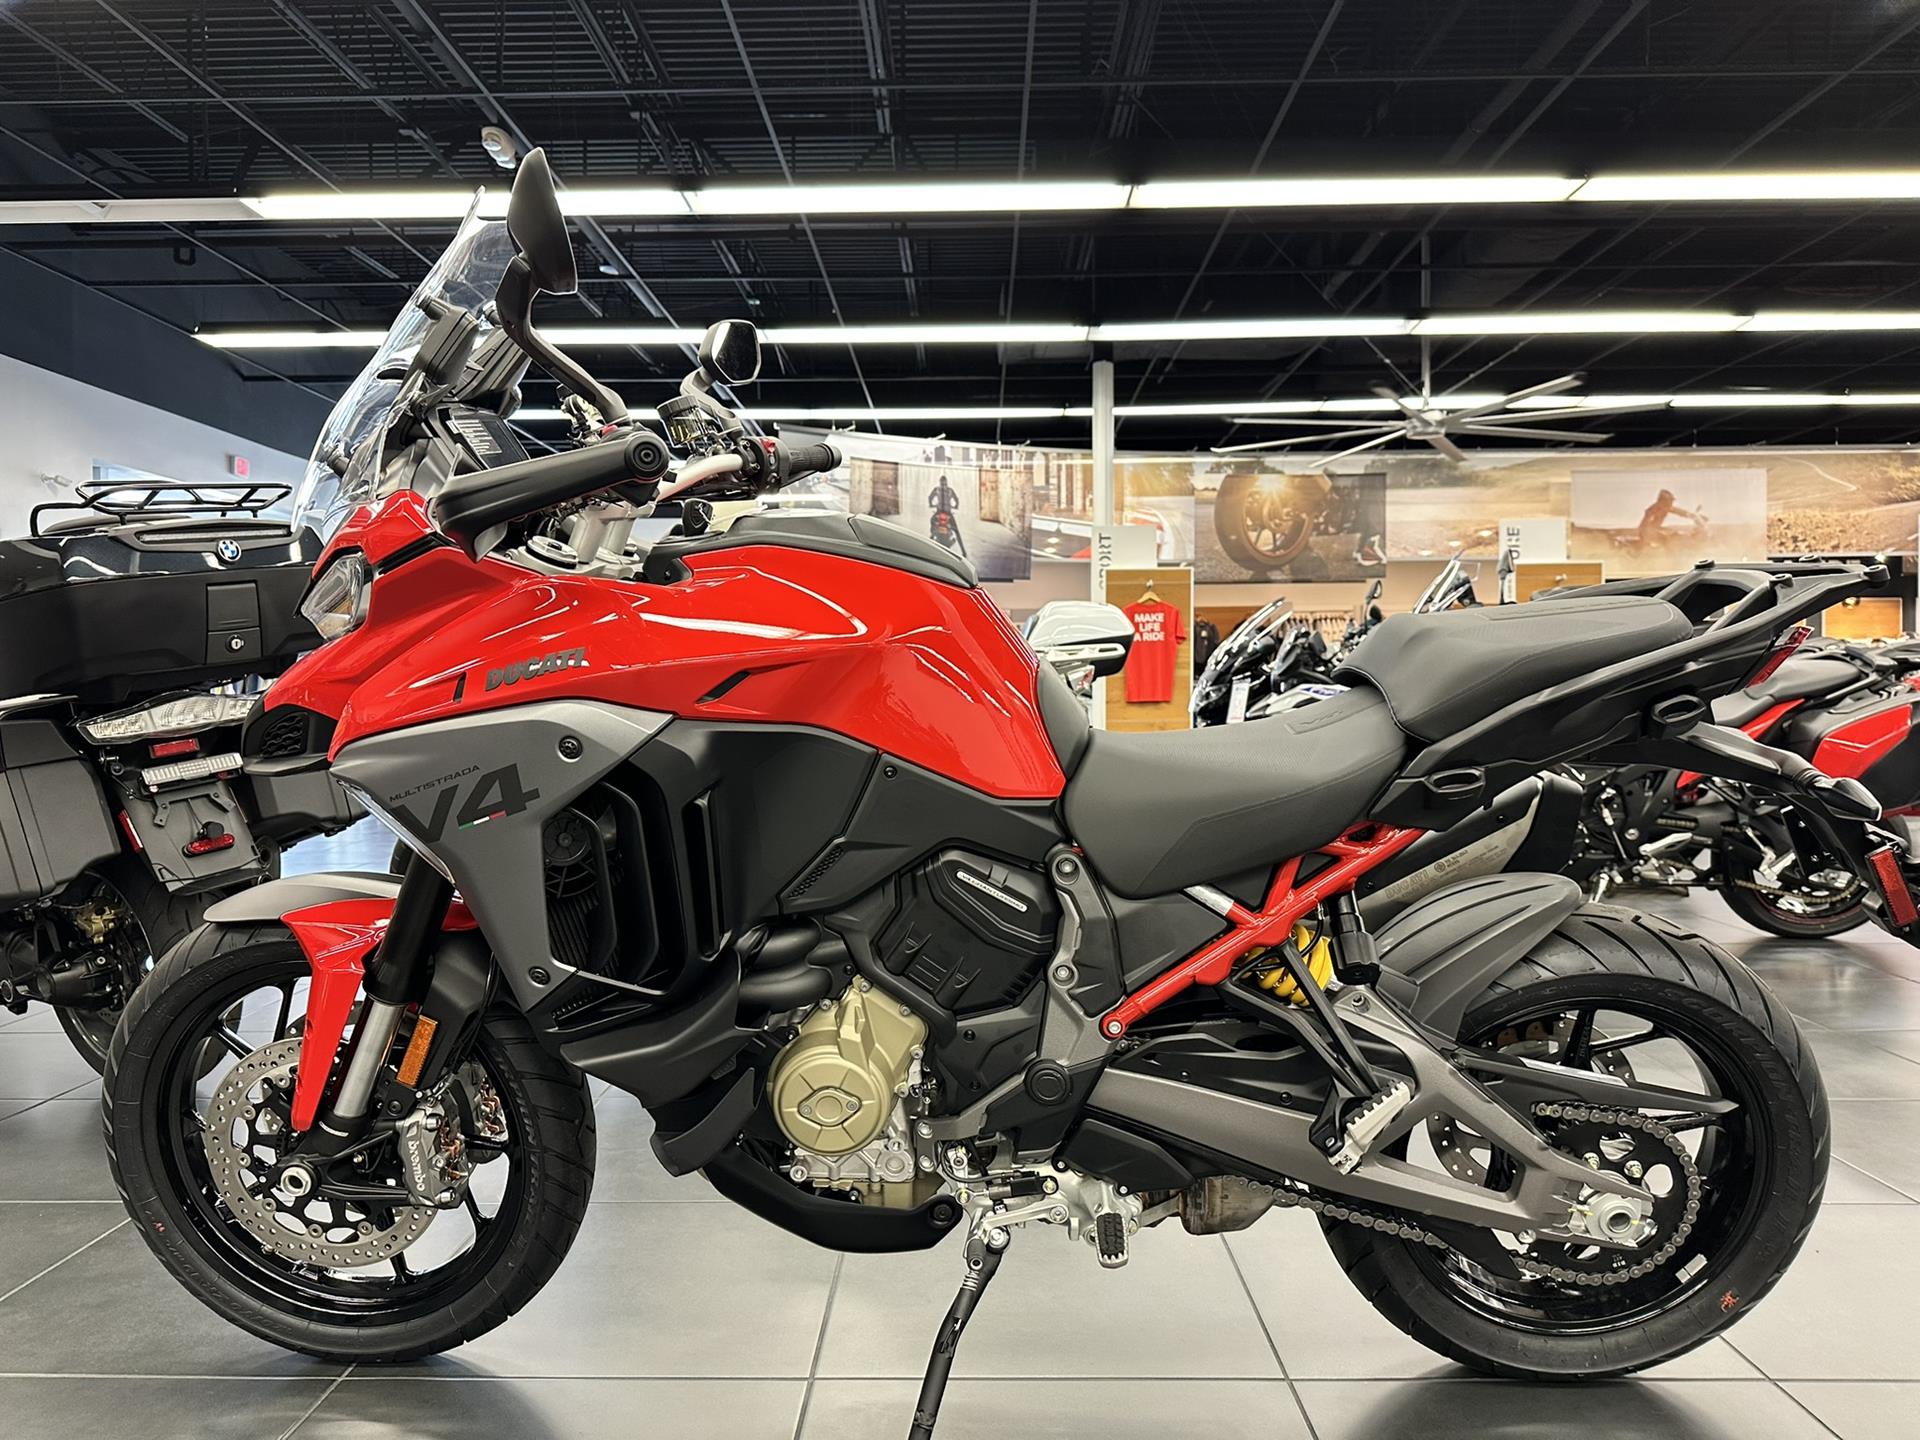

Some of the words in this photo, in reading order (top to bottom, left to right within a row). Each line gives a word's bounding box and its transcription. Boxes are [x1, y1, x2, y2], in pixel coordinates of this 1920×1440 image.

[1507, 527, 1520, 560] URE
[1134, 612, 1165, 623] MAKE
[1139, 622, 1161, 632] LIFE
[1133, 632, 1141, 641] A
[1142, 632, 1165, 641] RIDE
[485, 646, 587, 692] DUCATI
[389, 764, 481, 802] MULTISTRADA
[389, 763, 541, 845] V4
[407, 1140, 426, 1192] brembo
